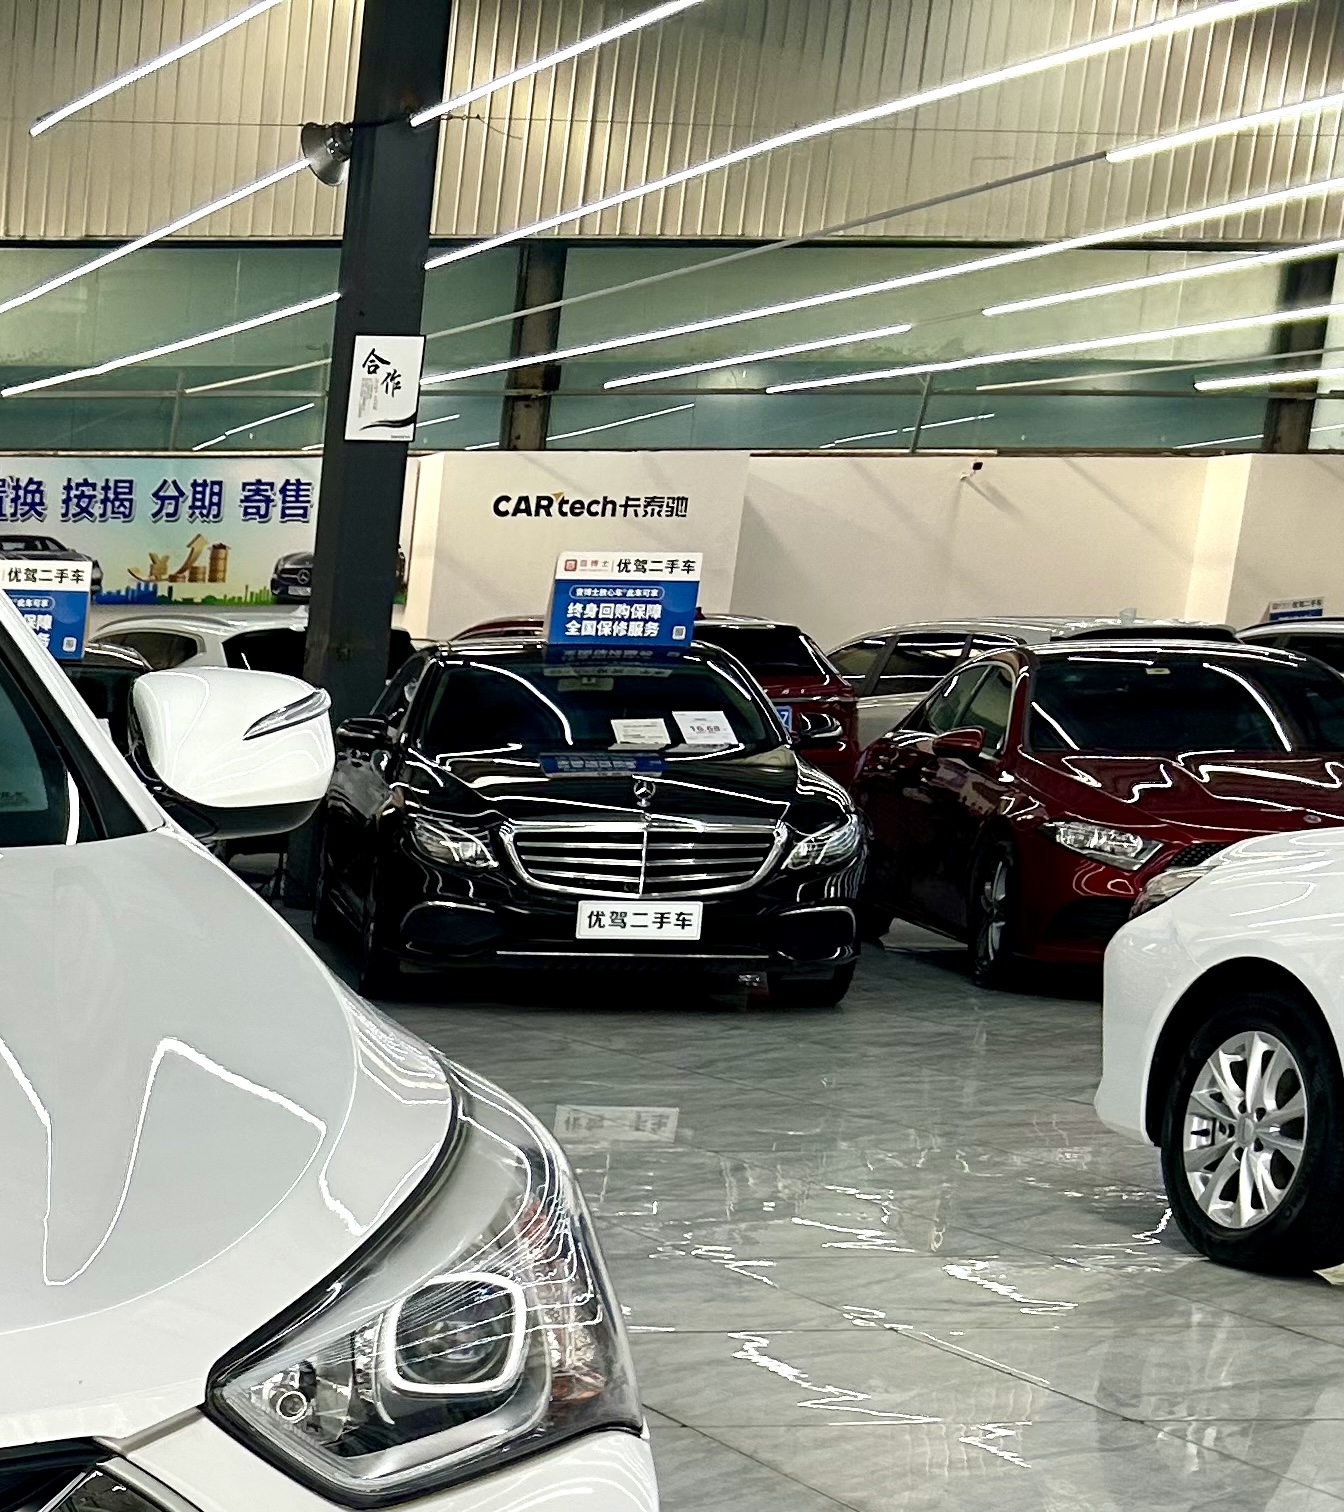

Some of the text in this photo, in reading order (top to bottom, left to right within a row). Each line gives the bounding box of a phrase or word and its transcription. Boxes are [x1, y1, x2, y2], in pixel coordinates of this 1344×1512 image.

[362, 348, 401, 398] 合作
[60, 476, 134, 523] 按揭
[150, 476, 224, 523] 分期
[239, 477, 314, 523] 寄售
[7, 567, 85, 583] 优驾二手车
[616, 558, 697, 575] 优驾二手车
[566, 602, 662, 619] 终身回购保障
[564, 620, 660, 637] 全国保修服务
[587, 910, 693, 930] 优驾二手车
